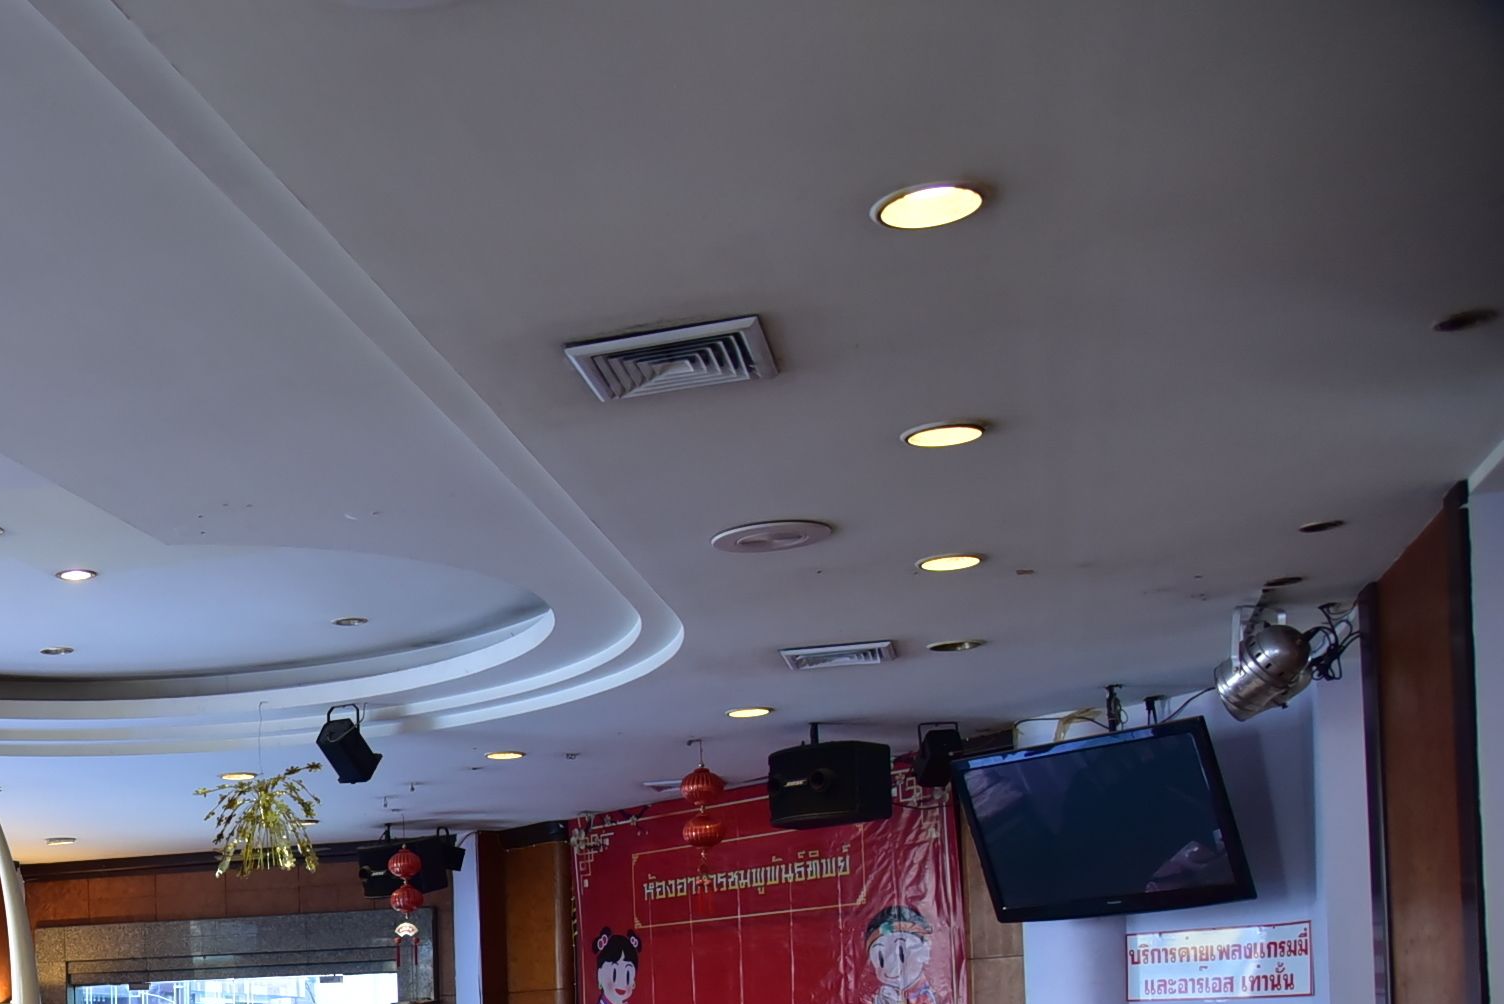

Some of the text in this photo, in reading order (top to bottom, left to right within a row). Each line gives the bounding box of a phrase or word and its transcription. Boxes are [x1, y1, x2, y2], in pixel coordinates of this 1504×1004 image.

[1128, 927, 1309, 966] บริการค่ายเพลงแกรมมี่
[1144, 961, 1295, 995] และอาร์เอส เท่านั้น
